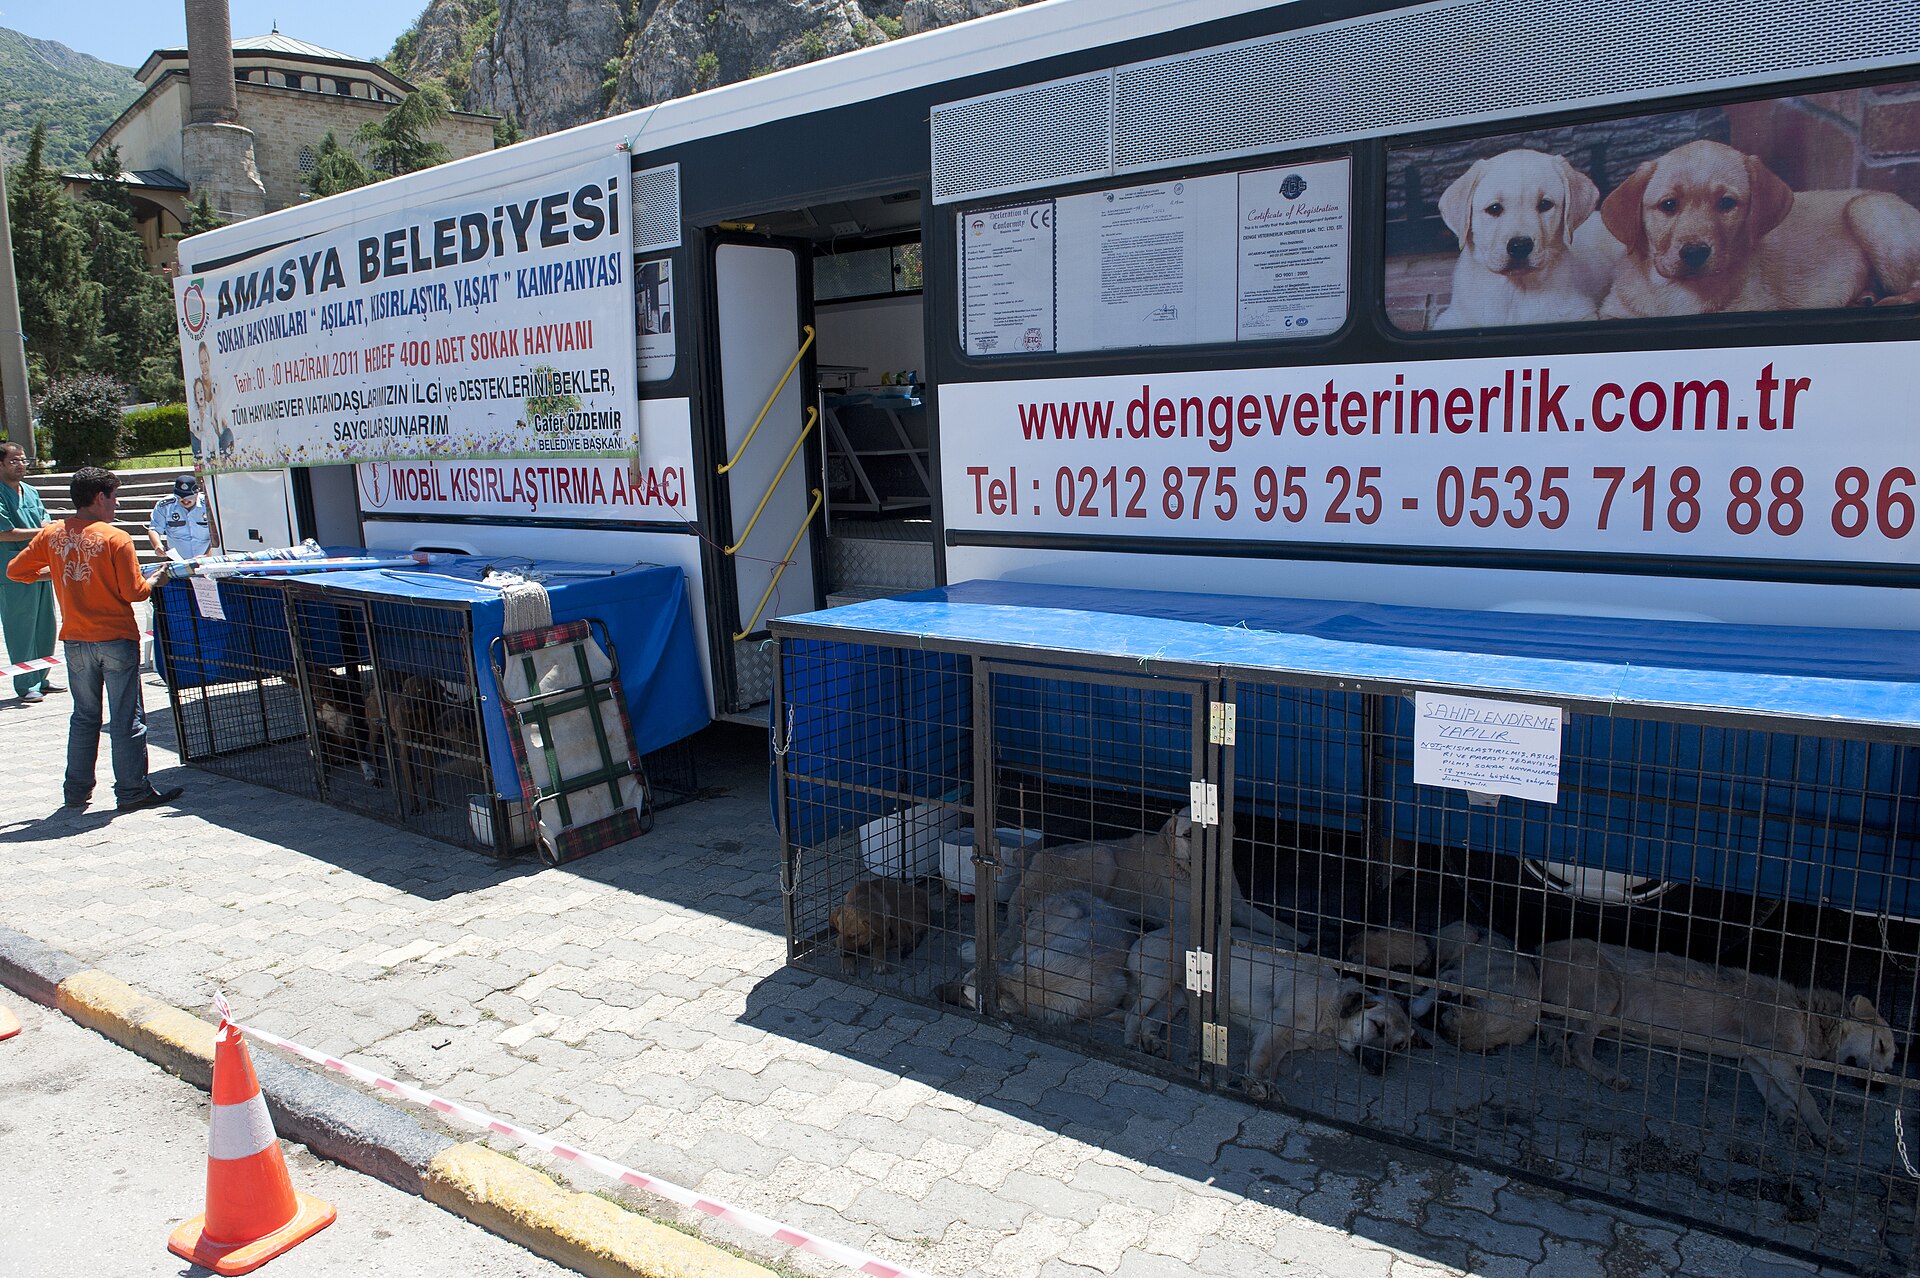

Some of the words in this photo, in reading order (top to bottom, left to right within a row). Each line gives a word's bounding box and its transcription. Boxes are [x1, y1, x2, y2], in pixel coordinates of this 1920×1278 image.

[1248, 208, 1283, 222] Certificate
[1286, 204, 1294, 219] of
[1296, 203, 1339, 217] Registration
[217, 247, 346, 319] AMASYA
[217, 325, 246, 354] SOKAK
[517, 252, 622, 299] KAMPANYASI
[256, 367, 266, 389] 01
[272, 362, 281, 386] 30
[284, 352, 330, 384] HAZİRAN
[332, 350, 359, 377] 2011
[364, 343, 395, 373] HEDEF
[400, 340, 430, 367] 400
[435, 335, 466, 366] ADET
[470, 328, 520, 361] SOKAK
[523, 319, 593, 356] HAYVANI
[249, 398, 305, 423] HAYVANSEVER
[445, 385, 458, 402] ve
[534, 414, 564, 432] Cafer
[1018, 362, 1811, 452] www.dengeveterinerlik.com.tr
[450, 466, 608, 513] KISIRLAŞTIRMA
[611, 466, 687, 507] ARACI
[967, 466, 1018, 516] Tel
[1055, 465, 1147, 518] 0212
[1162, 466, 1238, 522] 875
[1253, 466, 1307, 522] 95
[1324, 466, 1382, 525] 25
[1436, 466, 1569, 530] 0535
[1593, 465, 1702, 533] 718
[1726, 466, 1804, 537] 88
[1830, 466, 1917, 539] 86
